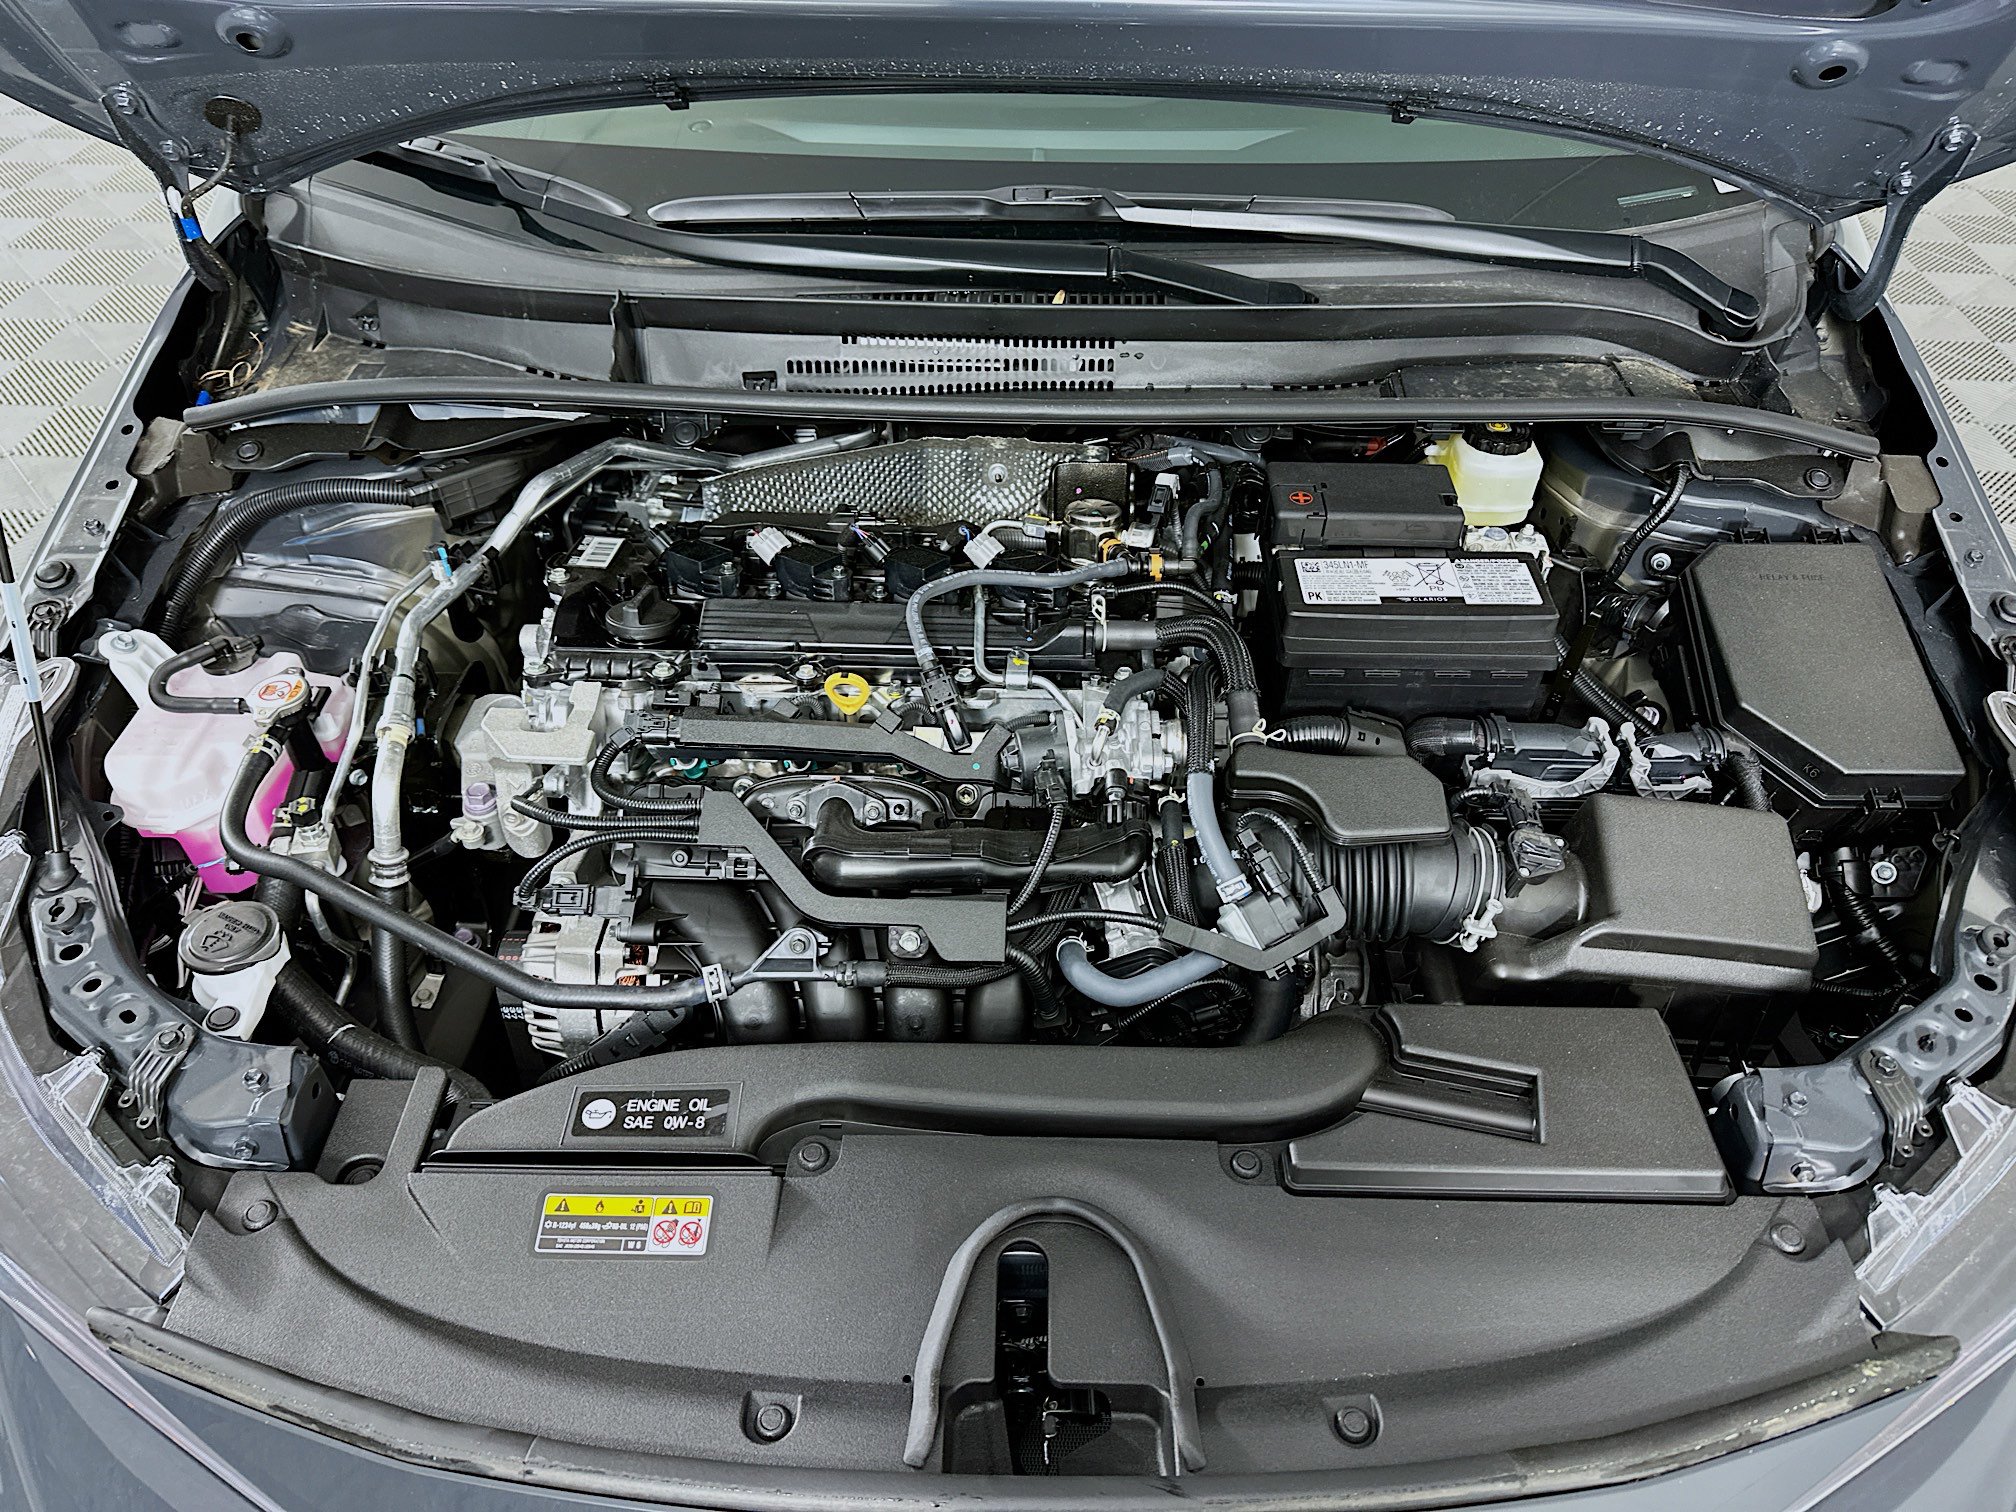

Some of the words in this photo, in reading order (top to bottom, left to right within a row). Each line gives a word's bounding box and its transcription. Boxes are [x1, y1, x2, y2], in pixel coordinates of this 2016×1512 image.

[1307, 591, 1323, 601] PK
[625, 1098, 681, 1113] ENGINE
[687, 1098, 712, 1113] OIL
[623, 1115, 653, 1129] SAE
[663, 1115, 706, 1130] 0W-8
